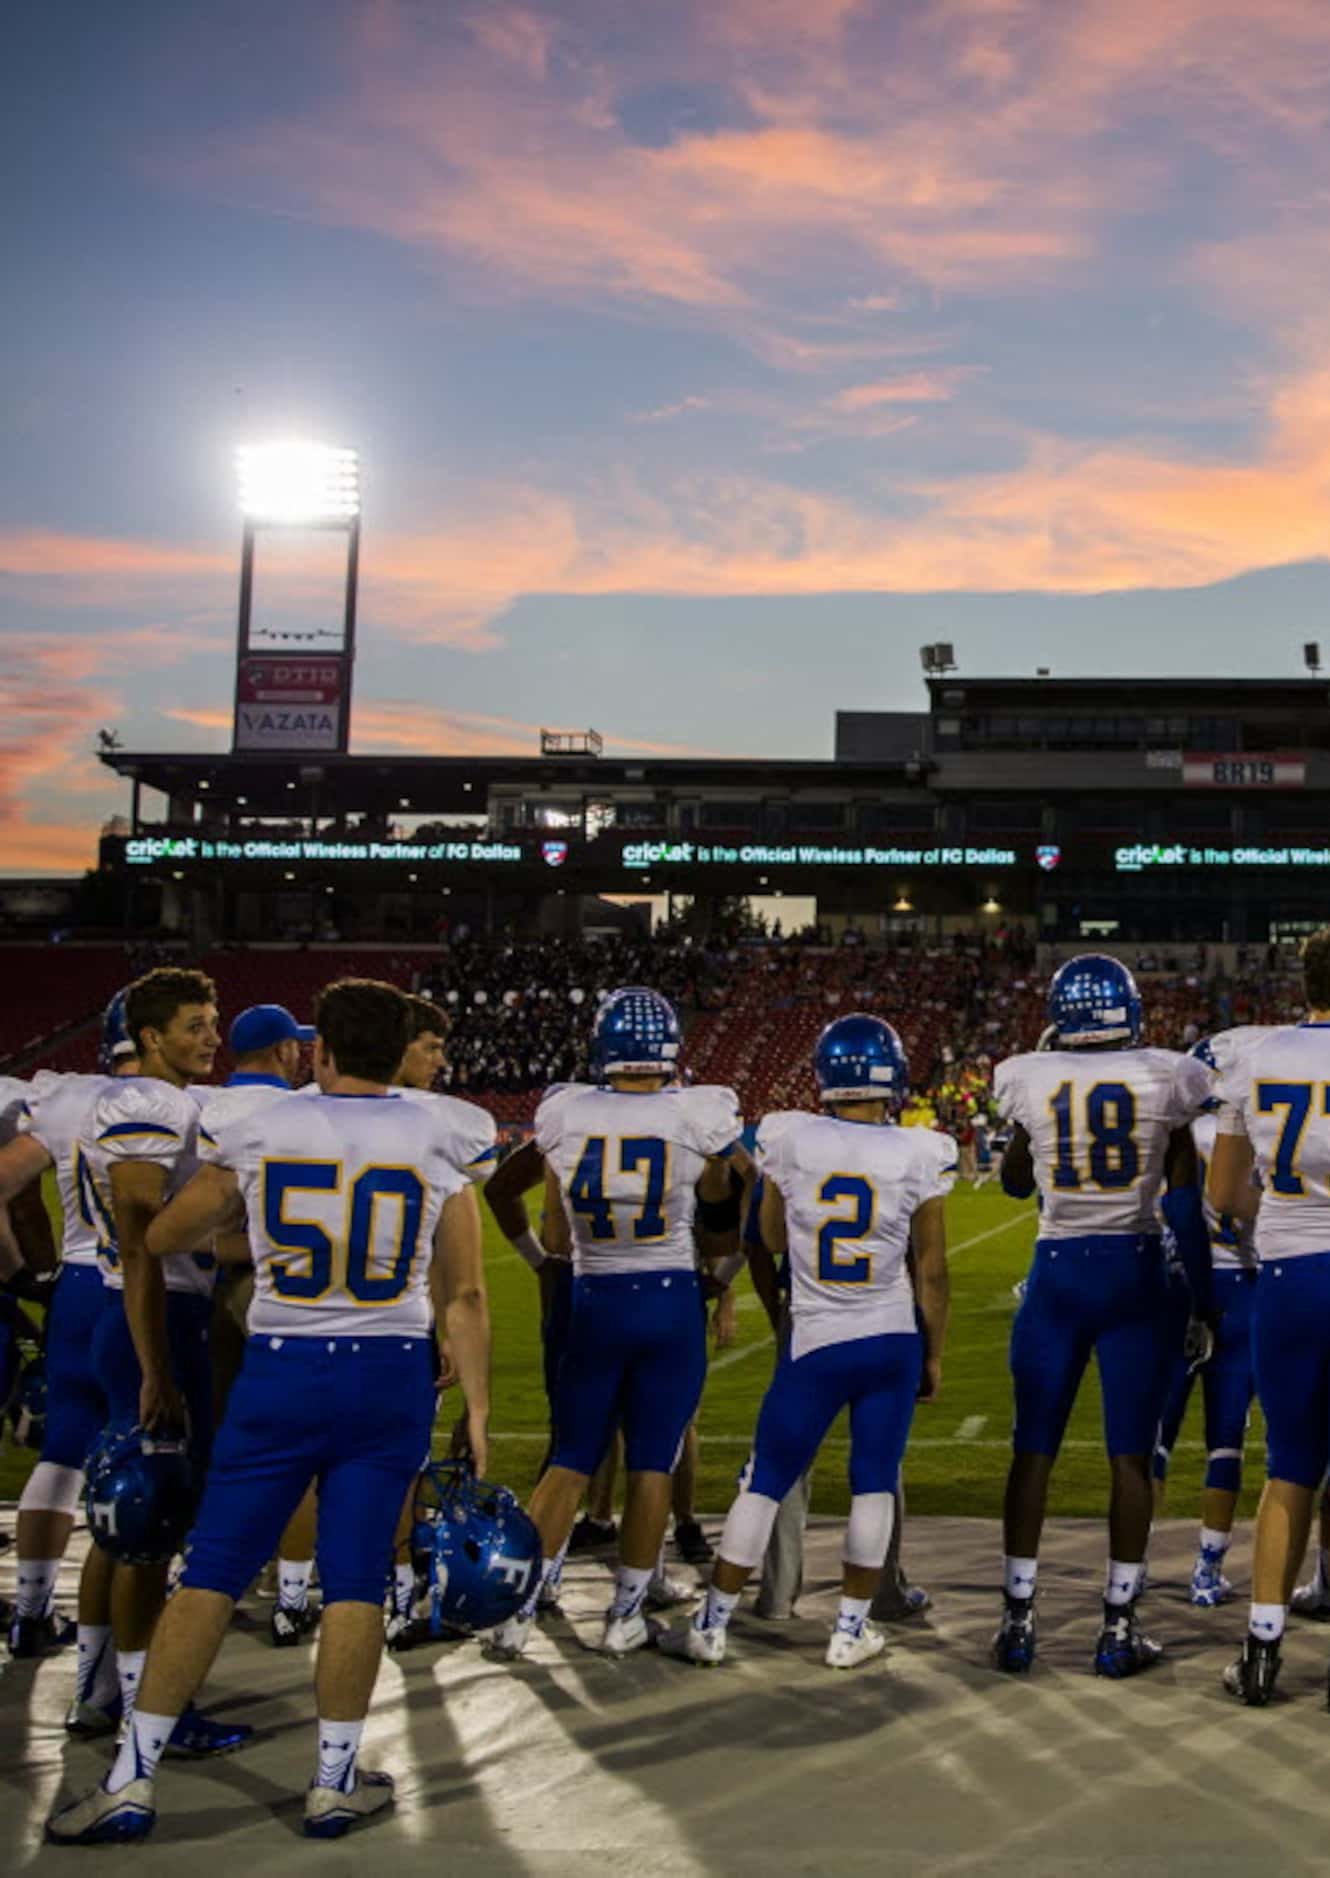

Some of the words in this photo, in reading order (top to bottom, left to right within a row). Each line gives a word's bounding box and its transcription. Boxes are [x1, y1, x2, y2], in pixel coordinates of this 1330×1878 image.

[201, 842, 215, 858] is
[216, 842, 243, 858] the
[243, 842, 301, 859] Official
[303, 842, 367, 859] Wireless
[369, 842, 426, 859] Partner
[427, 842, 446, 859] of
[446, 842, 469, 860] FC
[470, 842, 521, 860] Dallas
[697, 847, 711, 862] is
[712, 847, 739, 862] the
[739, 847, 797, 863] Official
[798, 847, 863, 863] Wireless
[864, 848, 922, 863] Partner
[923, 848, 940, 863] of
[941, 848, 964, 864] FC
[964, 848, 1016, 864] Dallas
[1189, 849, 1203, 864] is
[1204, 849, 1230, 864] the
[1231, 849, 1289, 864] Official
[568, 1135, 672, 1245] 47
[1048, 1080, 1140, 1193] 18
[261, 1157, 428, 1308] 50
[817, 1171, 878, 1288] 2
